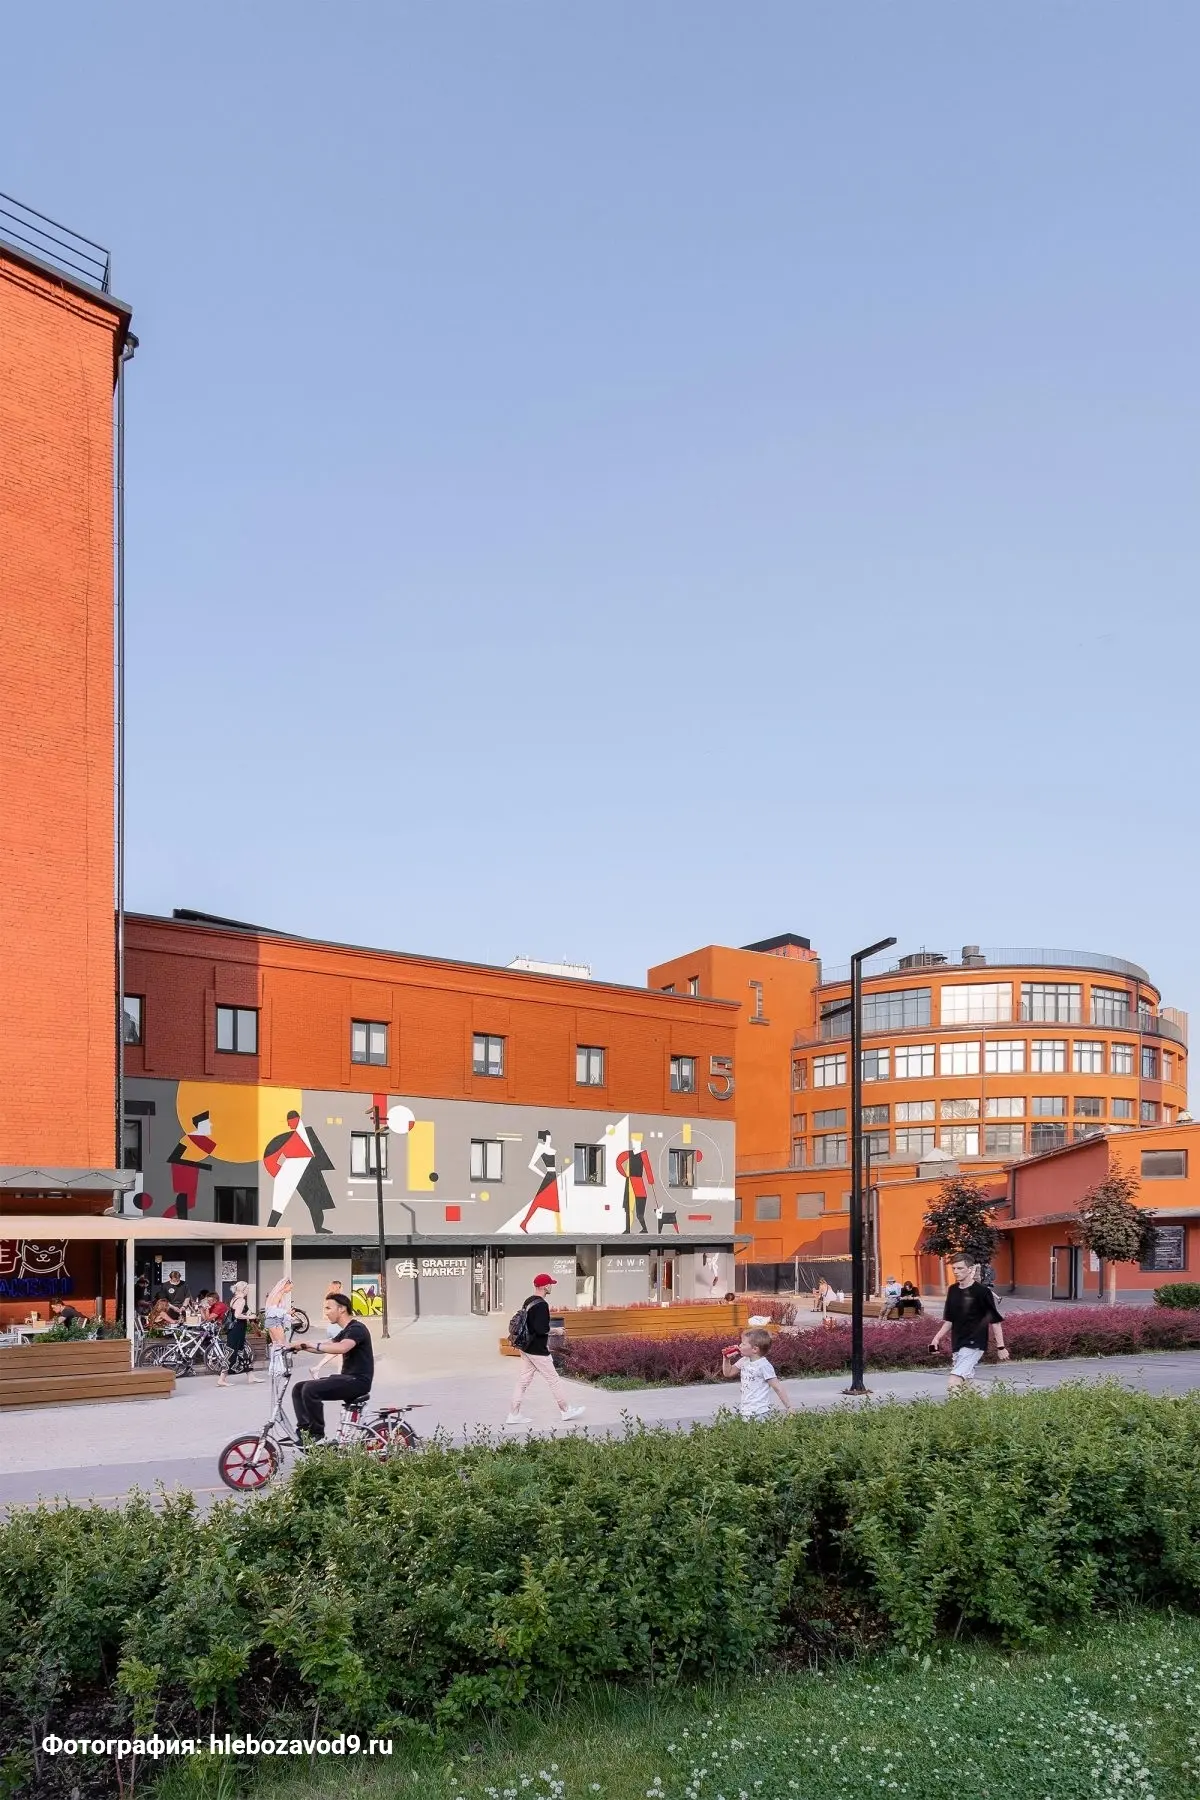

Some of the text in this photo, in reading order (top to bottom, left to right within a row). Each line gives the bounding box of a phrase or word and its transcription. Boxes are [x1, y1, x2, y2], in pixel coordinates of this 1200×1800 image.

[748, 980, 769, 1026] 1
[707, 1055, 735, 1101] 5
[422, 1259, 467, 1268] GRAFFITI
[422, 1267, 467, 1277] MARKET
